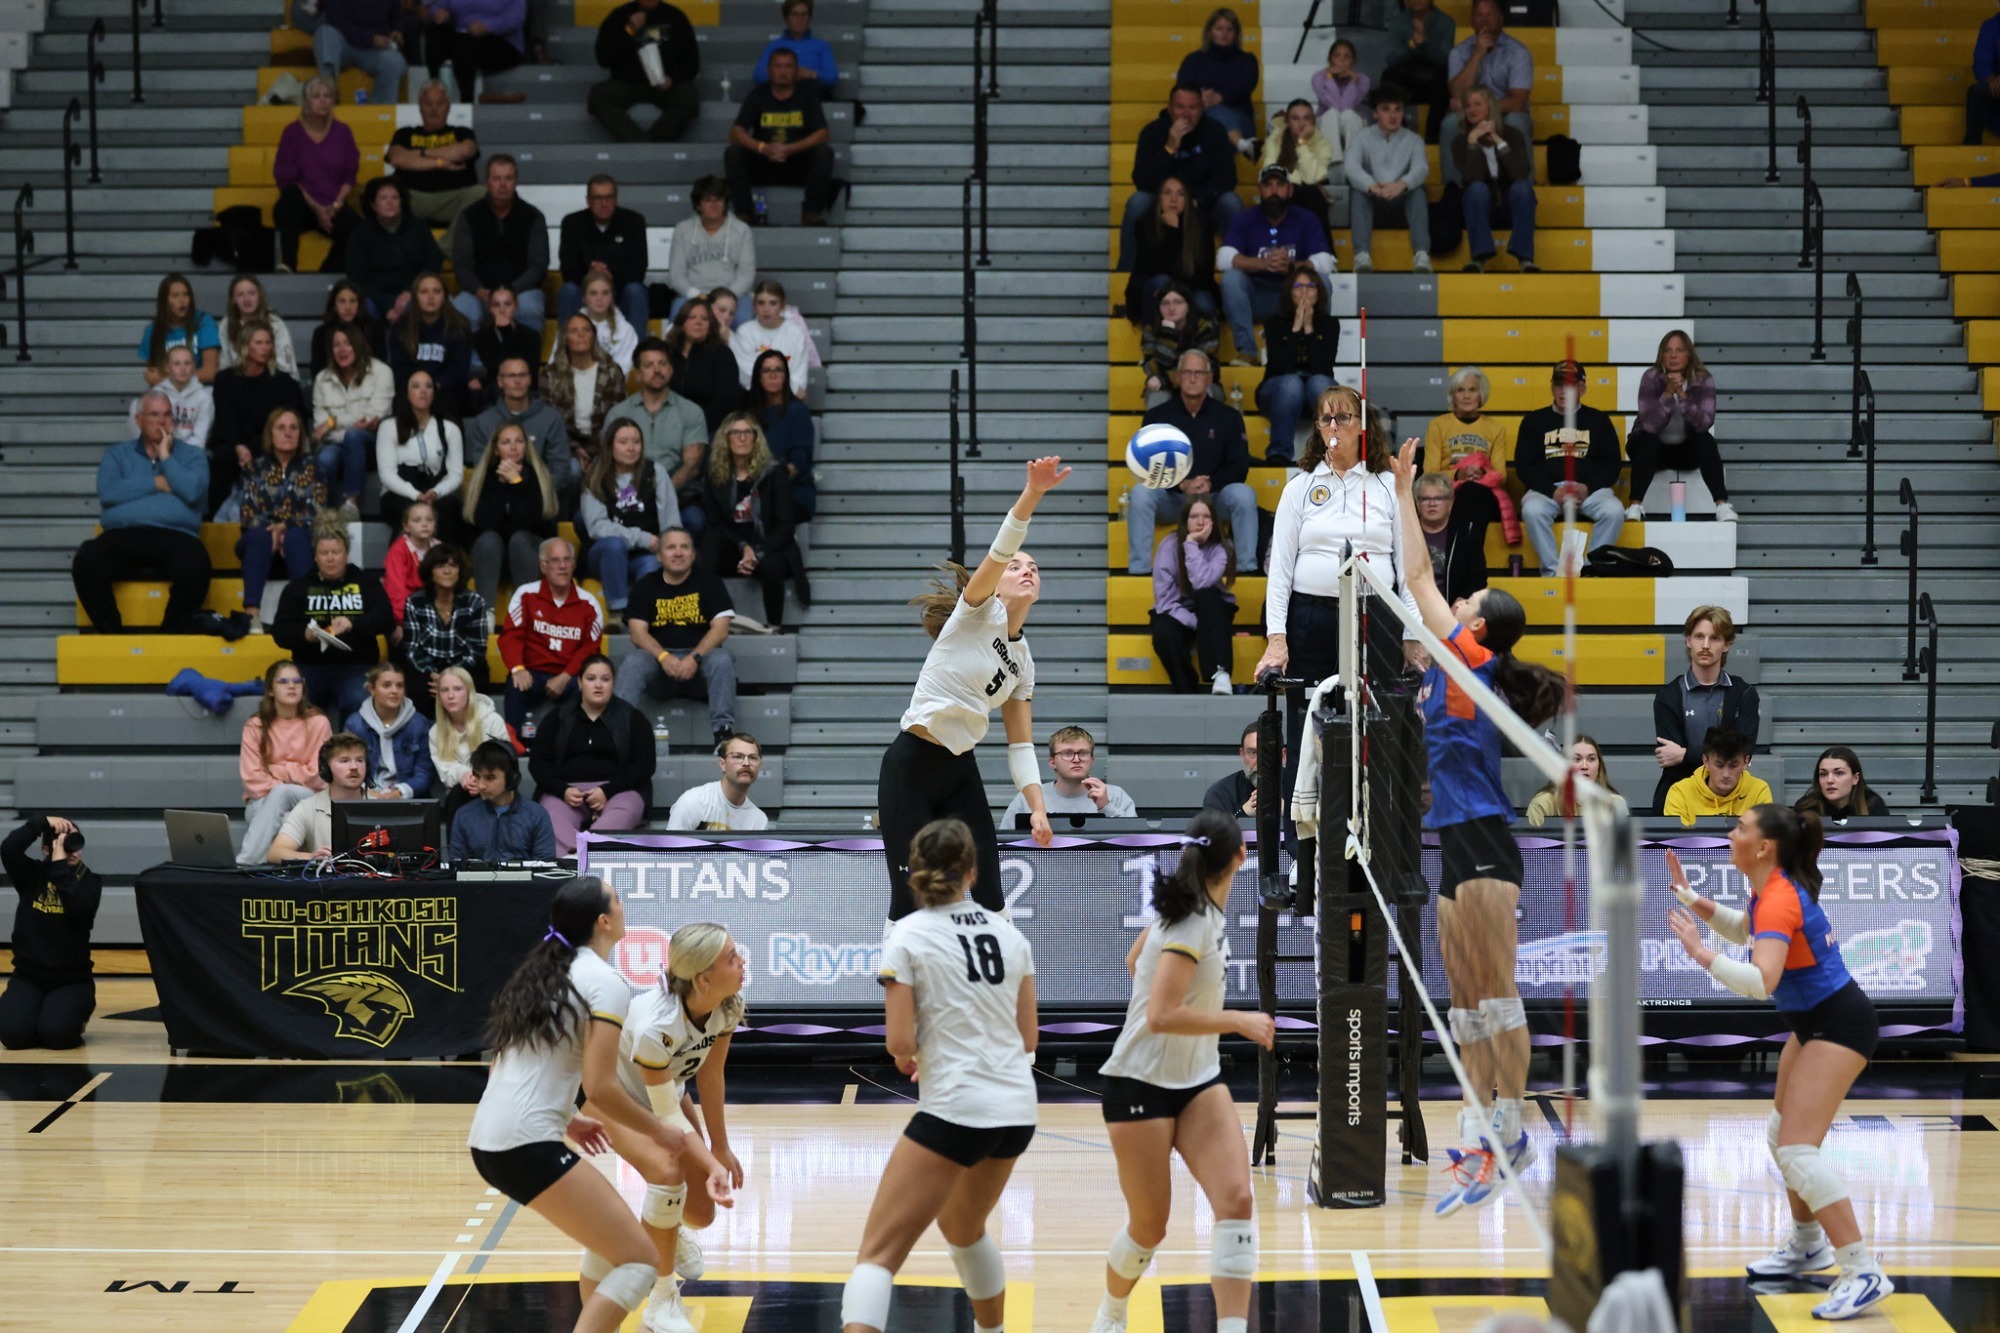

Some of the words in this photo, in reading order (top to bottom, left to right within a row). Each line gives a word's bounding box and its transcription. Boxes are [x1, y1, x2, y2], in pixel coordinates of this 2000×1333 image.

[307, 594, 363, 611] TITANS
[533, 619, 581, 641] NEBRASKA
[549, 638, 562, 652] N
[985, 667, 1006, 696] 5
[590, 860, 790, 900] TITANS
[1681, 862, 1940, 900] PIEERS
[242, 897, 457, 924] UW-OSHKOSH
[242, 922, 457, 992] TITANS
[772, 936, 883, 980] Rhym
[956, 934, 1005, 985] 18
[1516, 953, 1590, 983] mprint
[1346, 1009, 1361, 1060] sports
[679, 1057, 701, 1077] 2
[1346, 1063, 1361, 1126] imports
